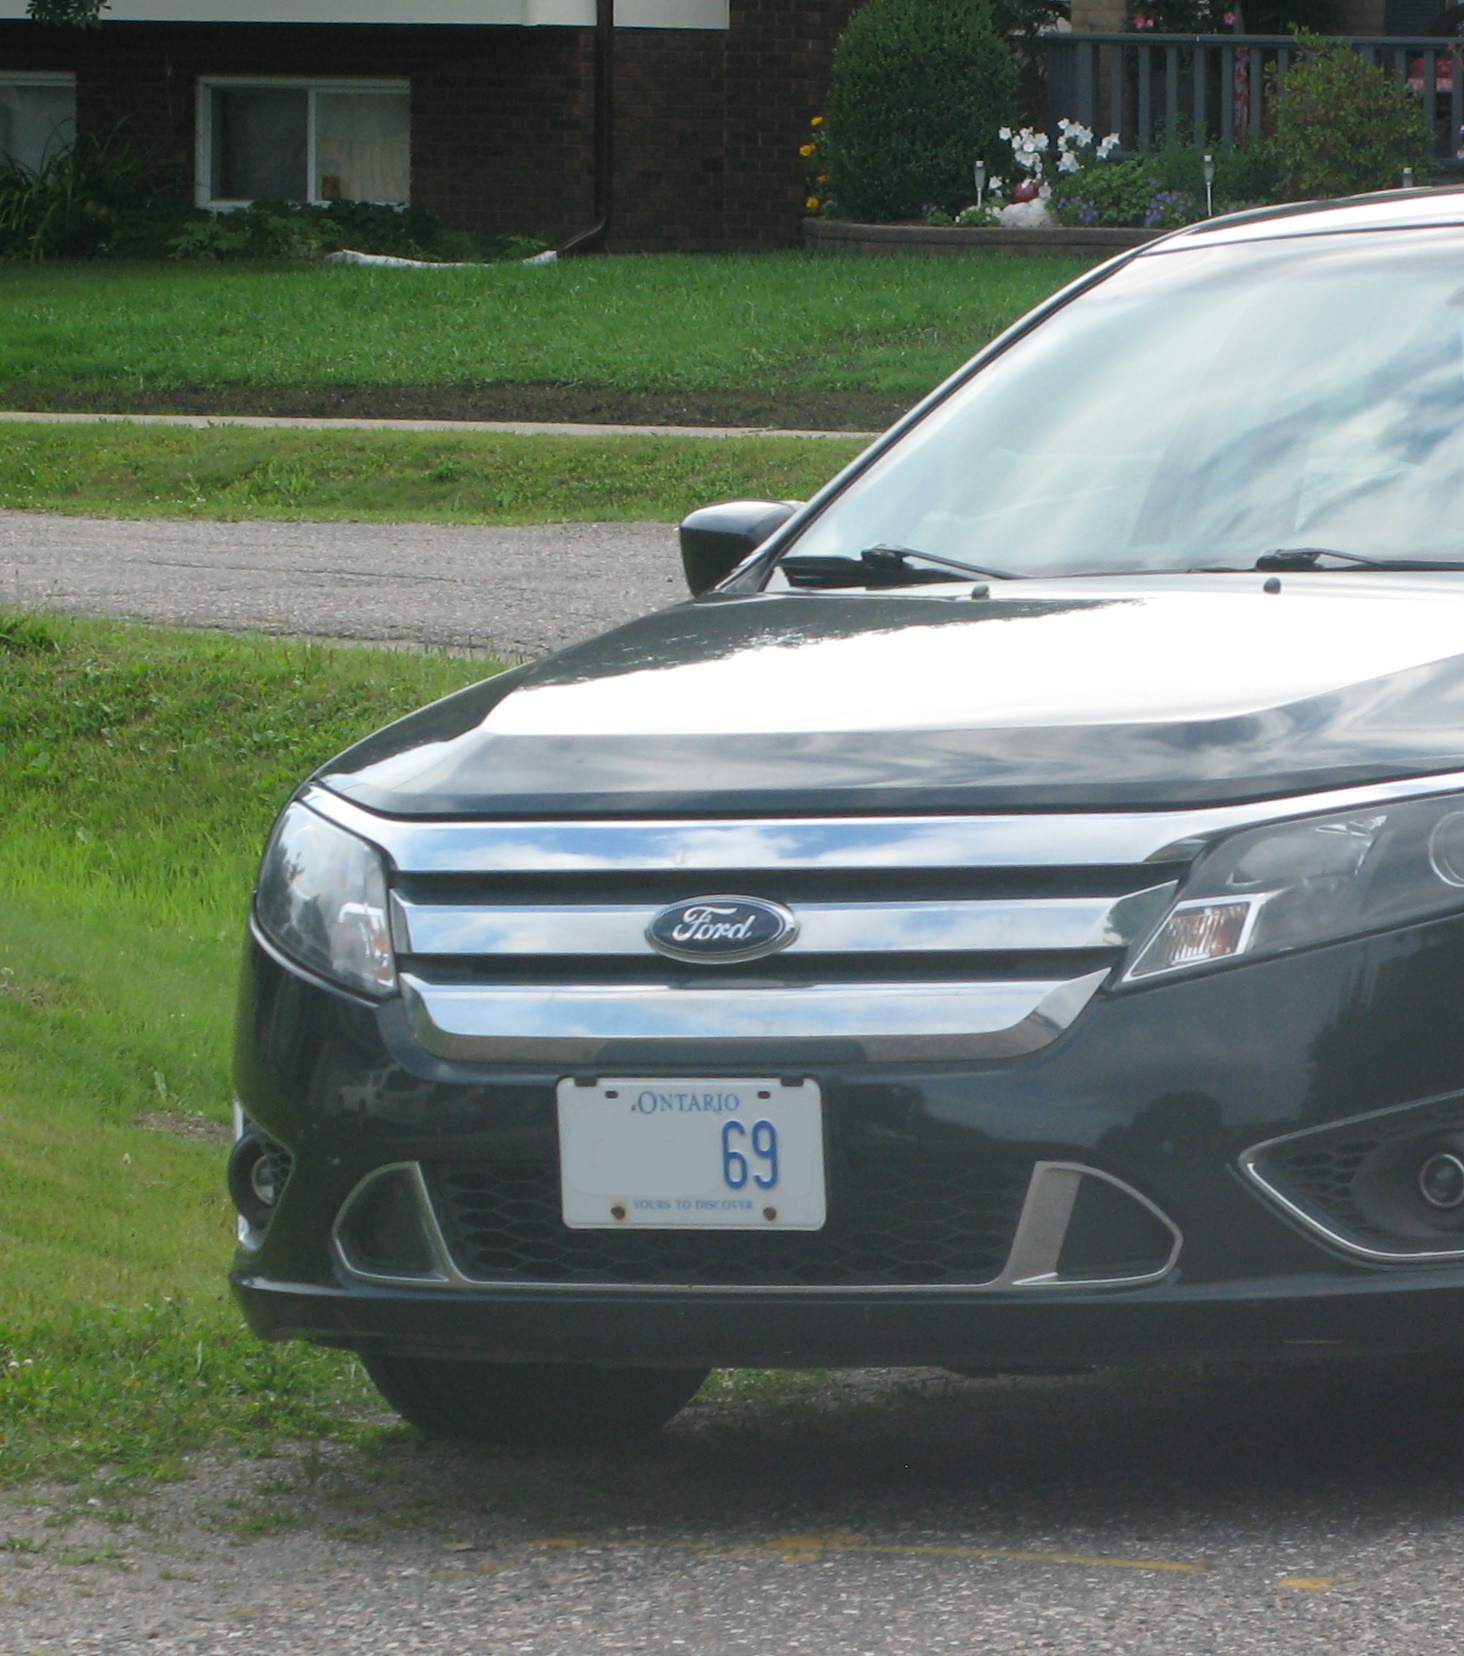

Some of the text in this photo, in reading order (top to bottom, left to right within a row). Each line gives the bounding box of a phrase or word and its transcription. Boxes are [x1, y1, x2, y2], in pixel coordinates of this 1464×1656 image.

[672, 905, 756, 941] Ford
[637, 1091, 740, 1114] ONTARIO
[721, 1120, 779, 1190] 69
[633, 1200, 754, 1210] YOURS TO DISCOVER
